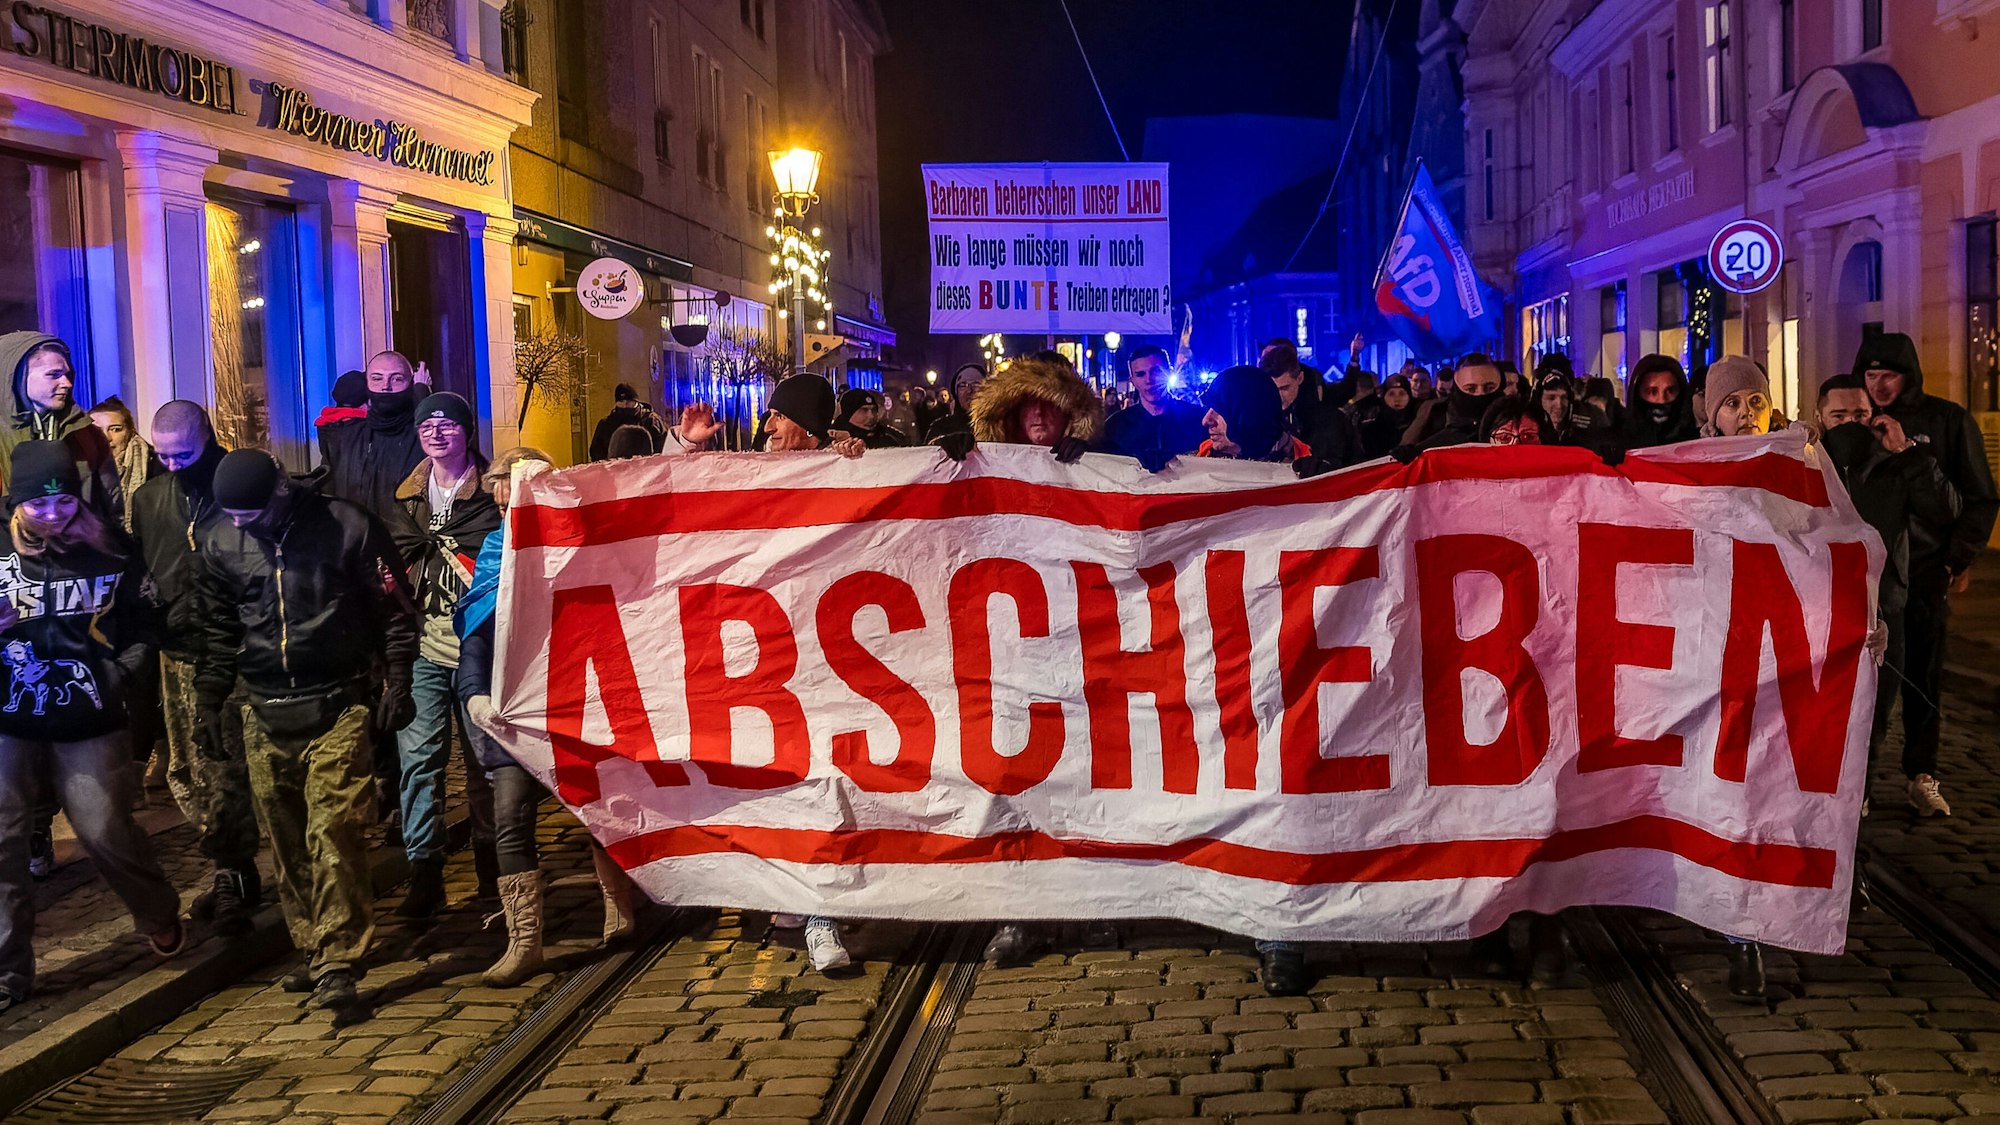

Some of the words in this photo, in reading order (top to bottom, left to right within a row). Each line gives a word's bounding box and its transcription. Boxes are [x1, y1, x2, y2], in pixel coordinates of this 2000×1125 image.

[271, 81, 385, 159] Werner
[390, 120, 495, 186] Hummel
[930, 180, 989, 217] Barbaren
[994, 179, 1076, 216] beherrschen
[1082, 184, 1120, 215] unser
[1126, 179, 1162, 214] LAND
[934, 234, 961, 267] Wie
[967, 234, 1007, 270] lange
[1013, 233, 1069, 267] müssen
[1078, 234, 1101, 267] wir
[1109, 234, 1144, 267] noch
[1388, 233, 1441, 308] AfD
[1726, 241, 1765, 272] 20
[583, 289, 627, 308] Suppen
[936, 280, 971, 311] dieses
[978, 279, 1060, 311] BUNTE
[1066, 280, 1108, 313] Treiben
[1111, 284, 1160, 317] ertragen
[547, 522, 1869, 808] ABSCHIEBEN
